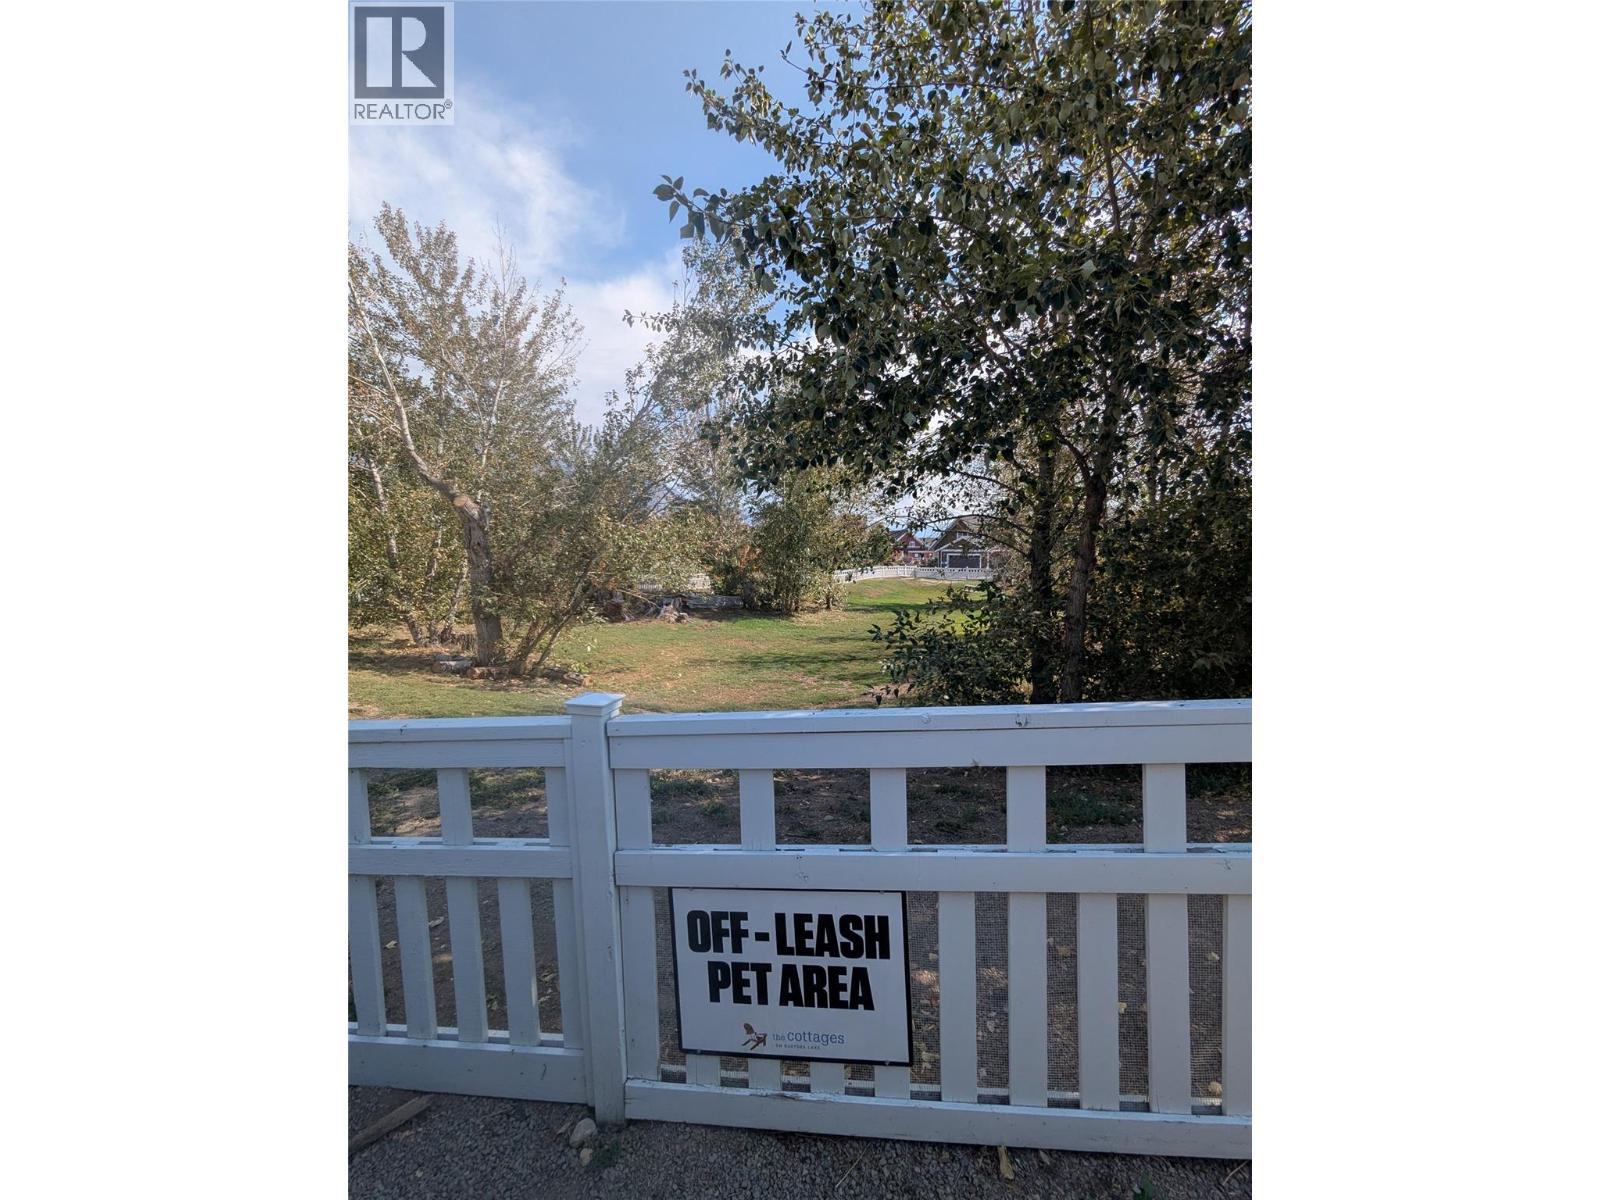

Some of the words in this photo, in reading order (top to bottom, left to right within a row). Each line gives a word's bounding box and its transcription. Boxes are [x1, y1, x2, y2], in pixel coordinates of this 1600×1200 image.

[707, 960, 772, 1006] PET
[778, 963, 875, 1011] AREA
[772, 1033, 786, 1041] the
[787, 1031, 845, 1046] cottages
